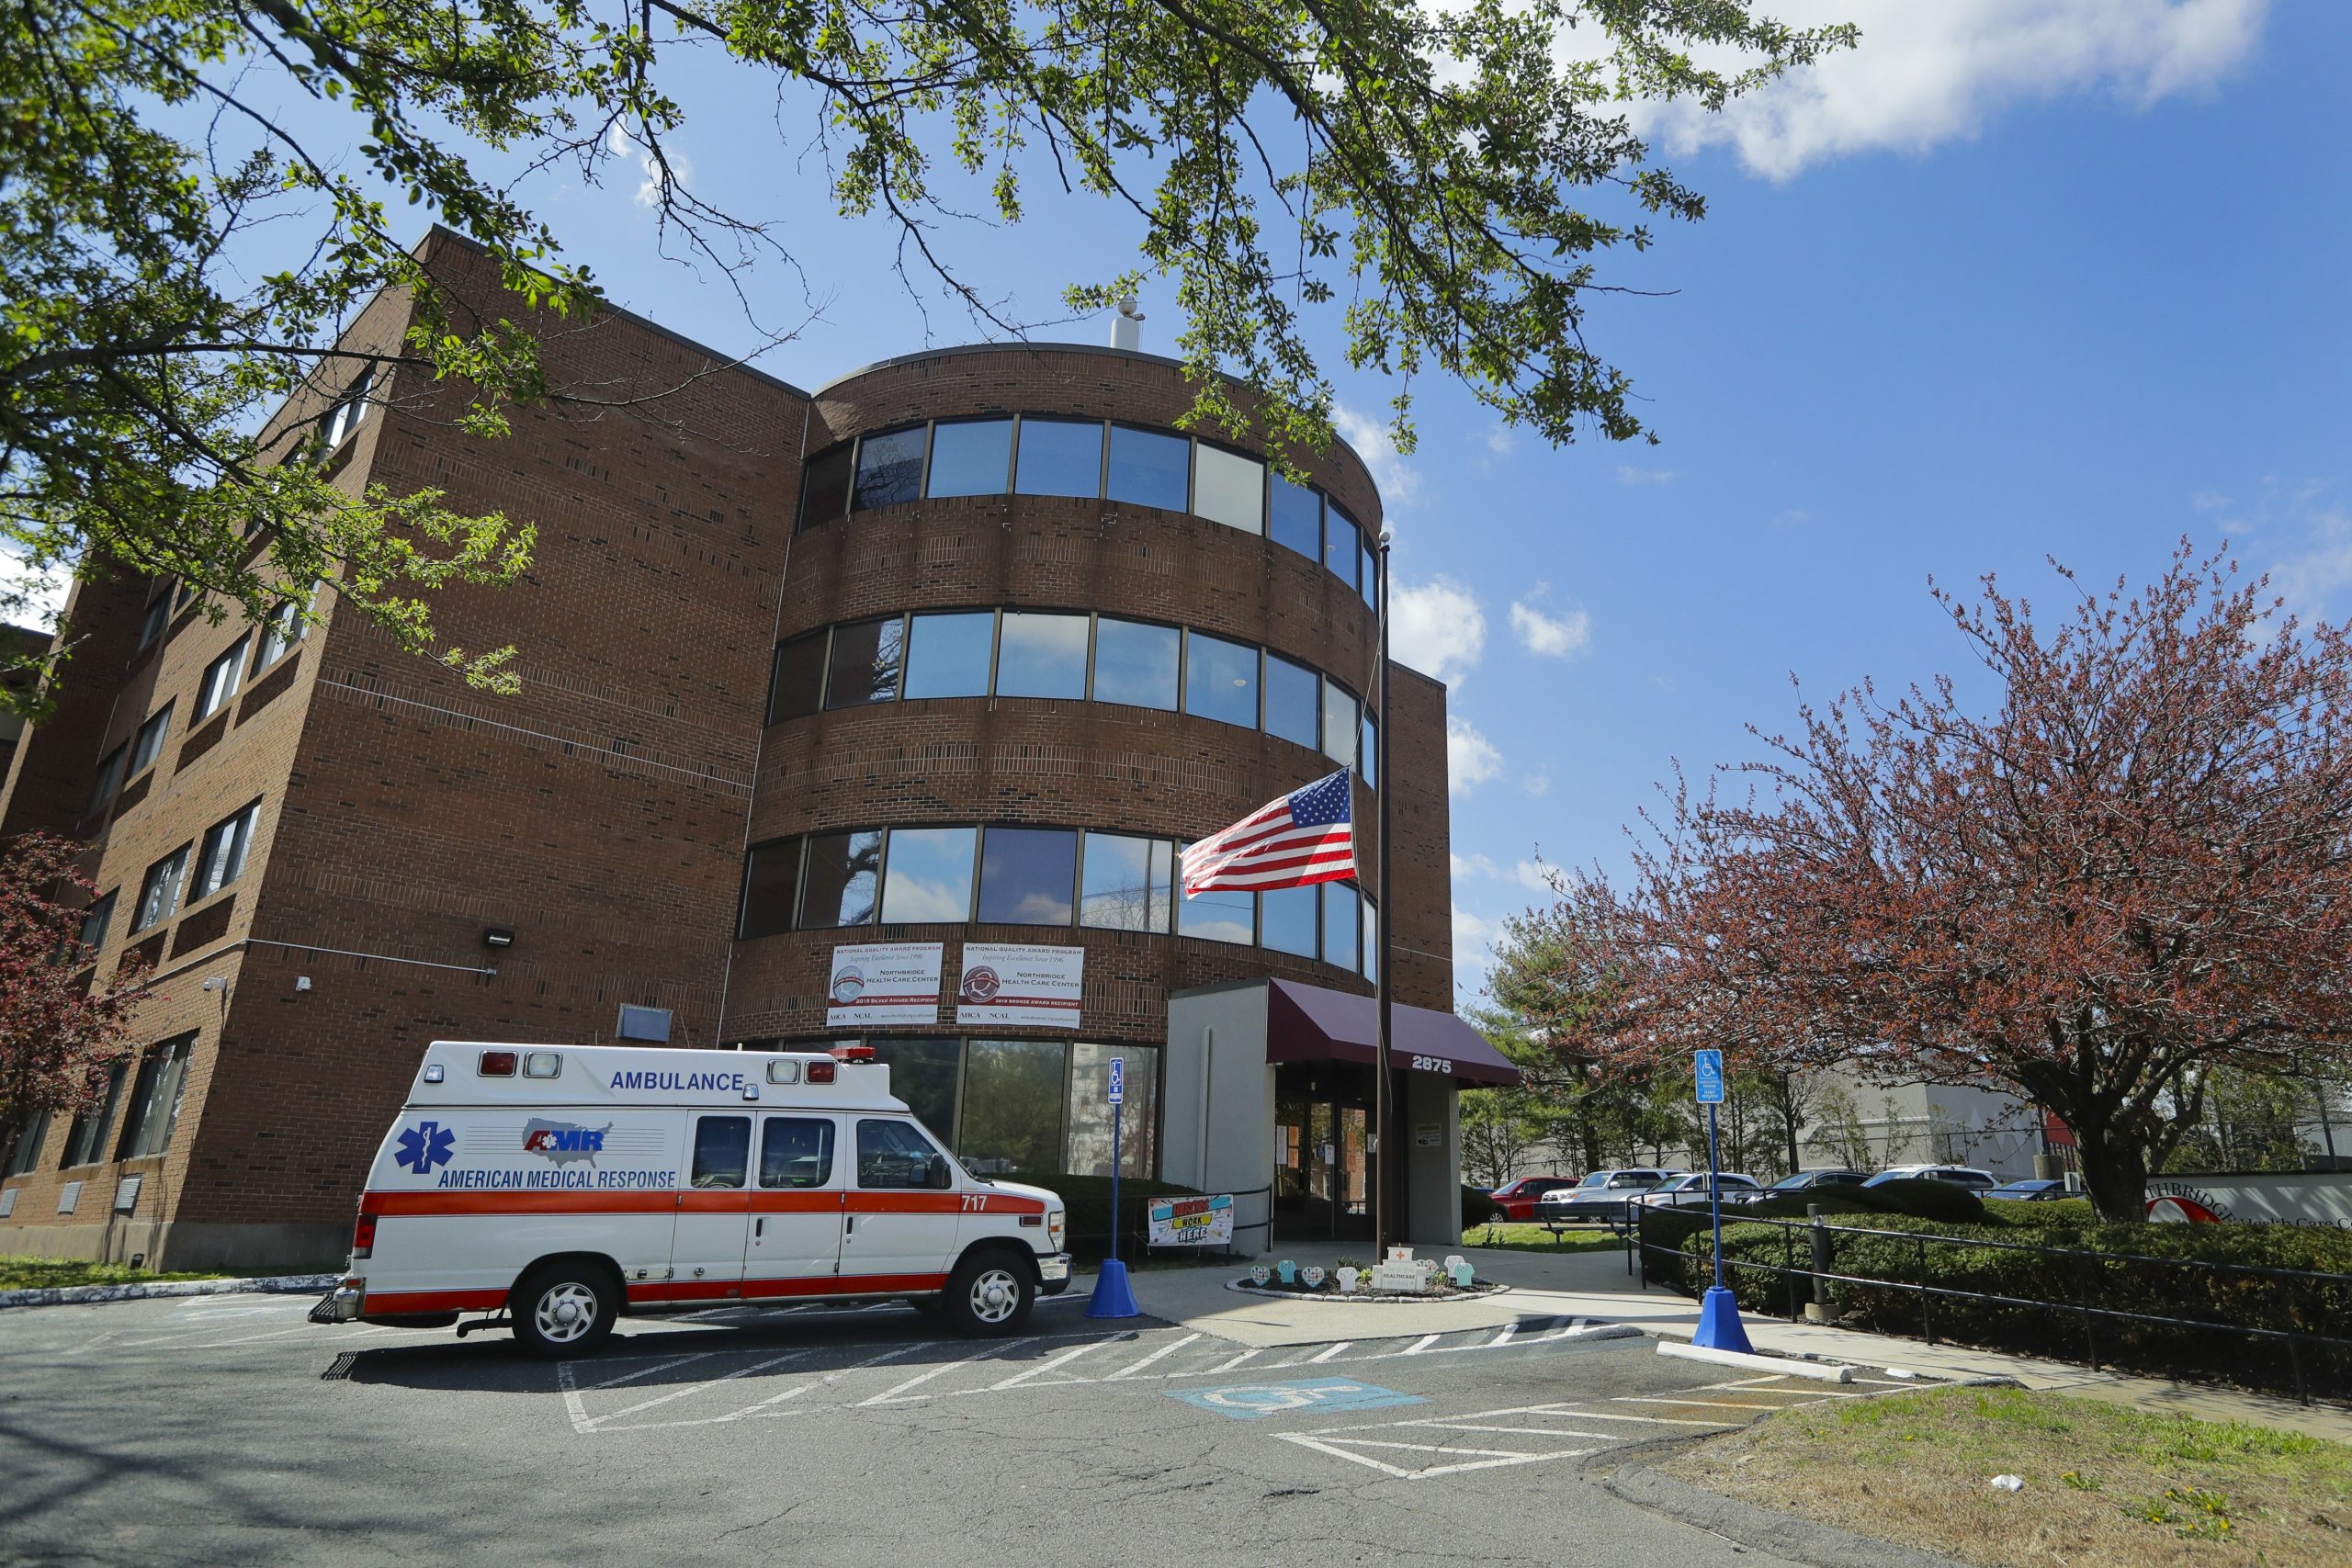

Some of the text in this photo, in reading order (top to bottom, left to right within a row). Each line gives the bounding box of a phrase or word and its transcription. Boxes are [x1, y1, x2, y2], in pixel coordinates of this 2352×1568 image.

[1411, 1055, 1452, 1074] 2875
[610, 1071, 744, 1091] AMBULANCE
[524, 1130, 604, 1151] AMR
[438, 1170, 676, 1188] AMERICAN MEDICAL RESPONSE
[961, 1194, 988, 1211] 717
[2146, 1182, 2236, 1223] THBRIDGE
[1182, 1216, 1202, 1226] WORK
[1177, 1227, 1207, 1244] HERE
